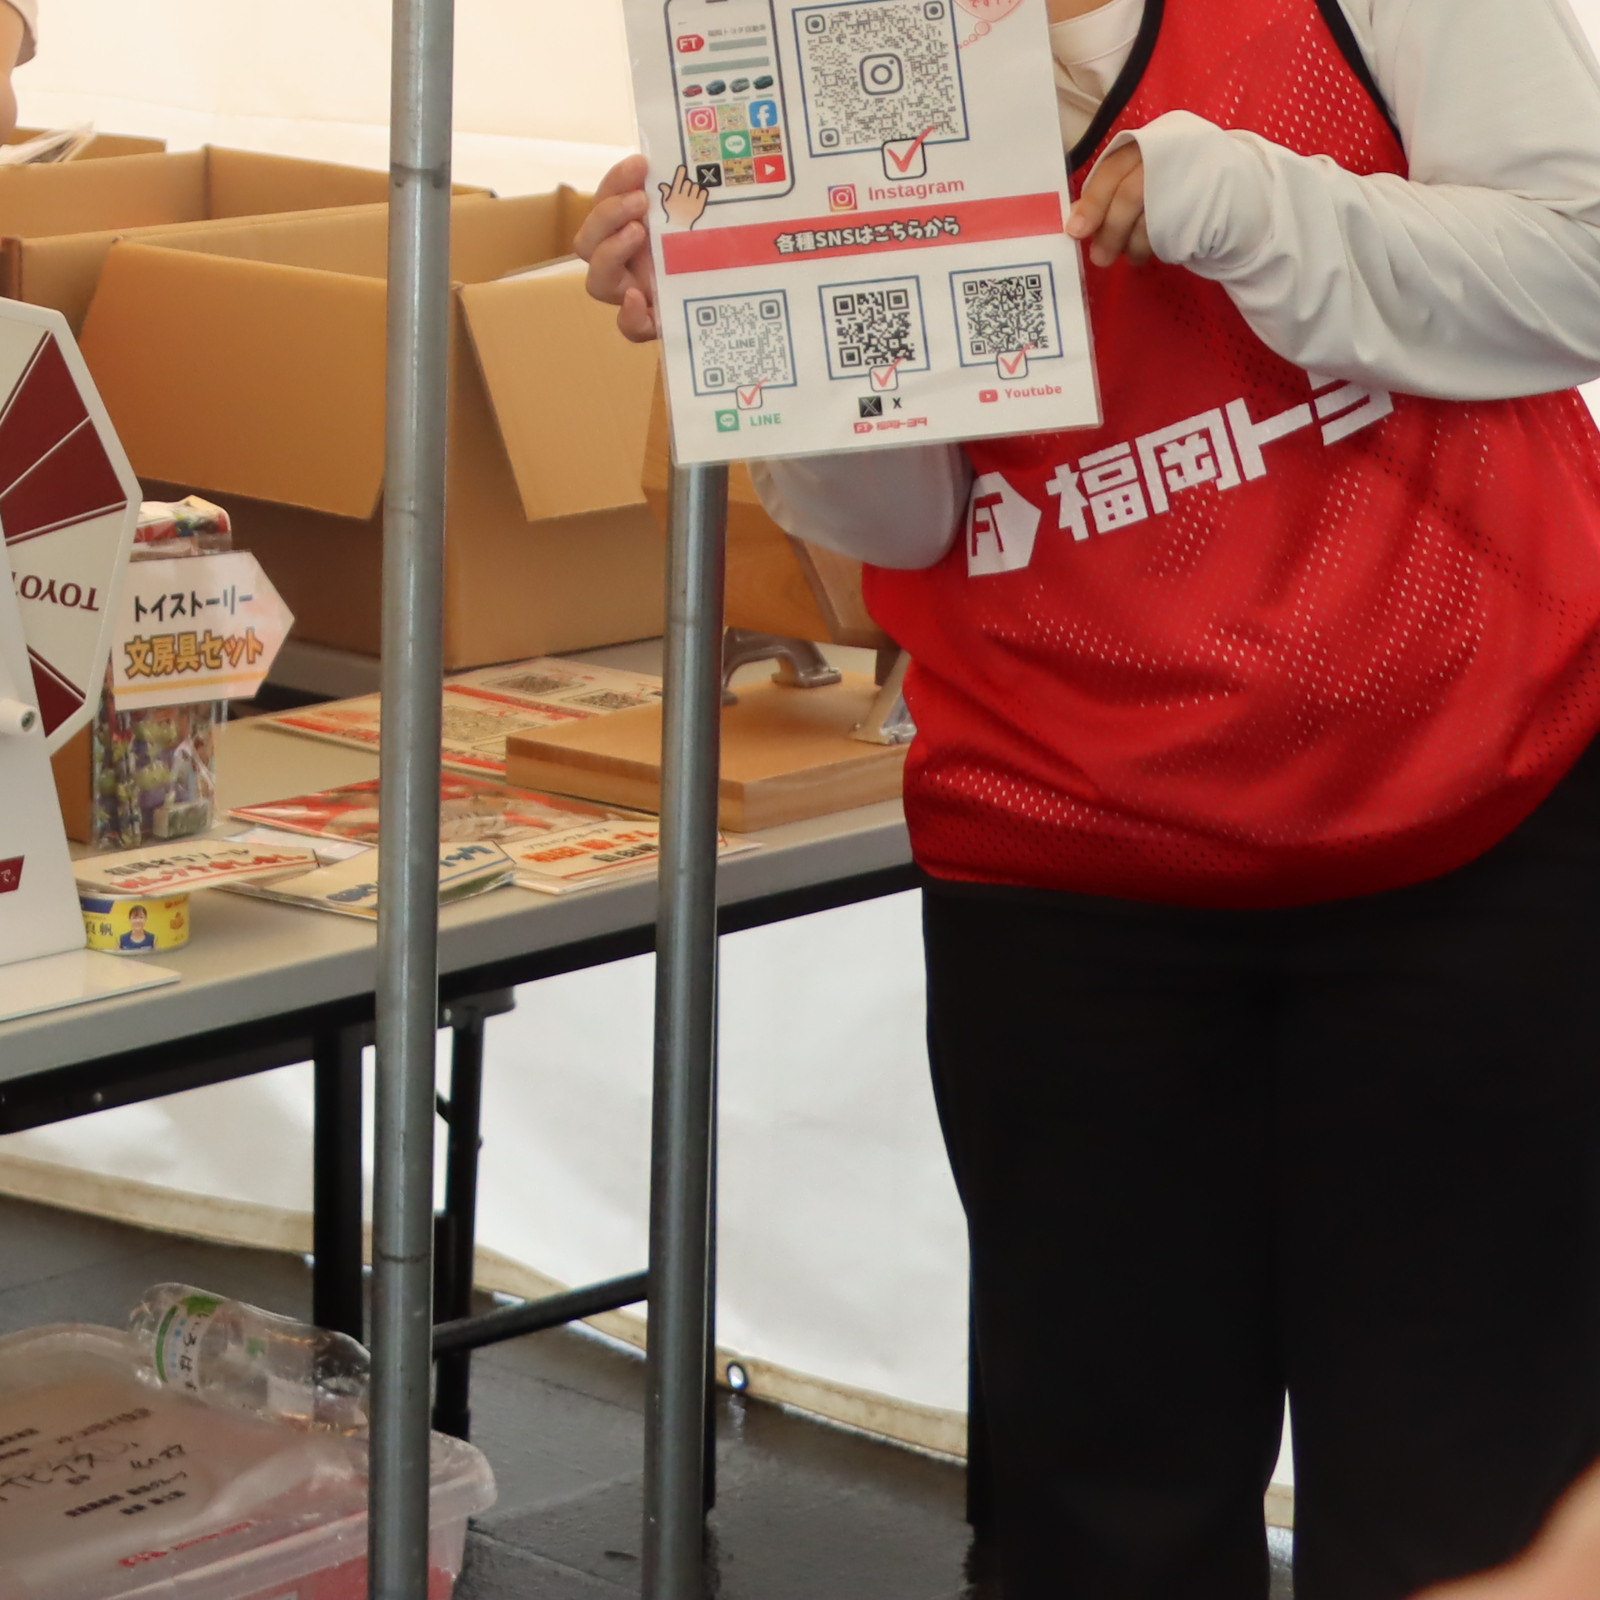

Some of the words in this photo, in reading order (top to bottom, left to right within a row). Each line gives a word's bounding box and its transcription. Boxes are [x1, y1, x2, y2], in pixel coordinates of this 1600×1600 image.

[679, 37, 699, 50] FT
[867, 178, 966, 202] Instagram
[774, 215, 962, 255] 各種SNSはこちらから
[727, 336, 757, 351] LINE
[1003, 383, 1063, 400] Youtube
[892, 397, 902, 410] X
[749, 413, 783, 428] LINE
[11, 570, 100, 613] TOYO
[133, 584, 253, 623] トイストーリー
[124, 626, 265, 680] 文房具セット
